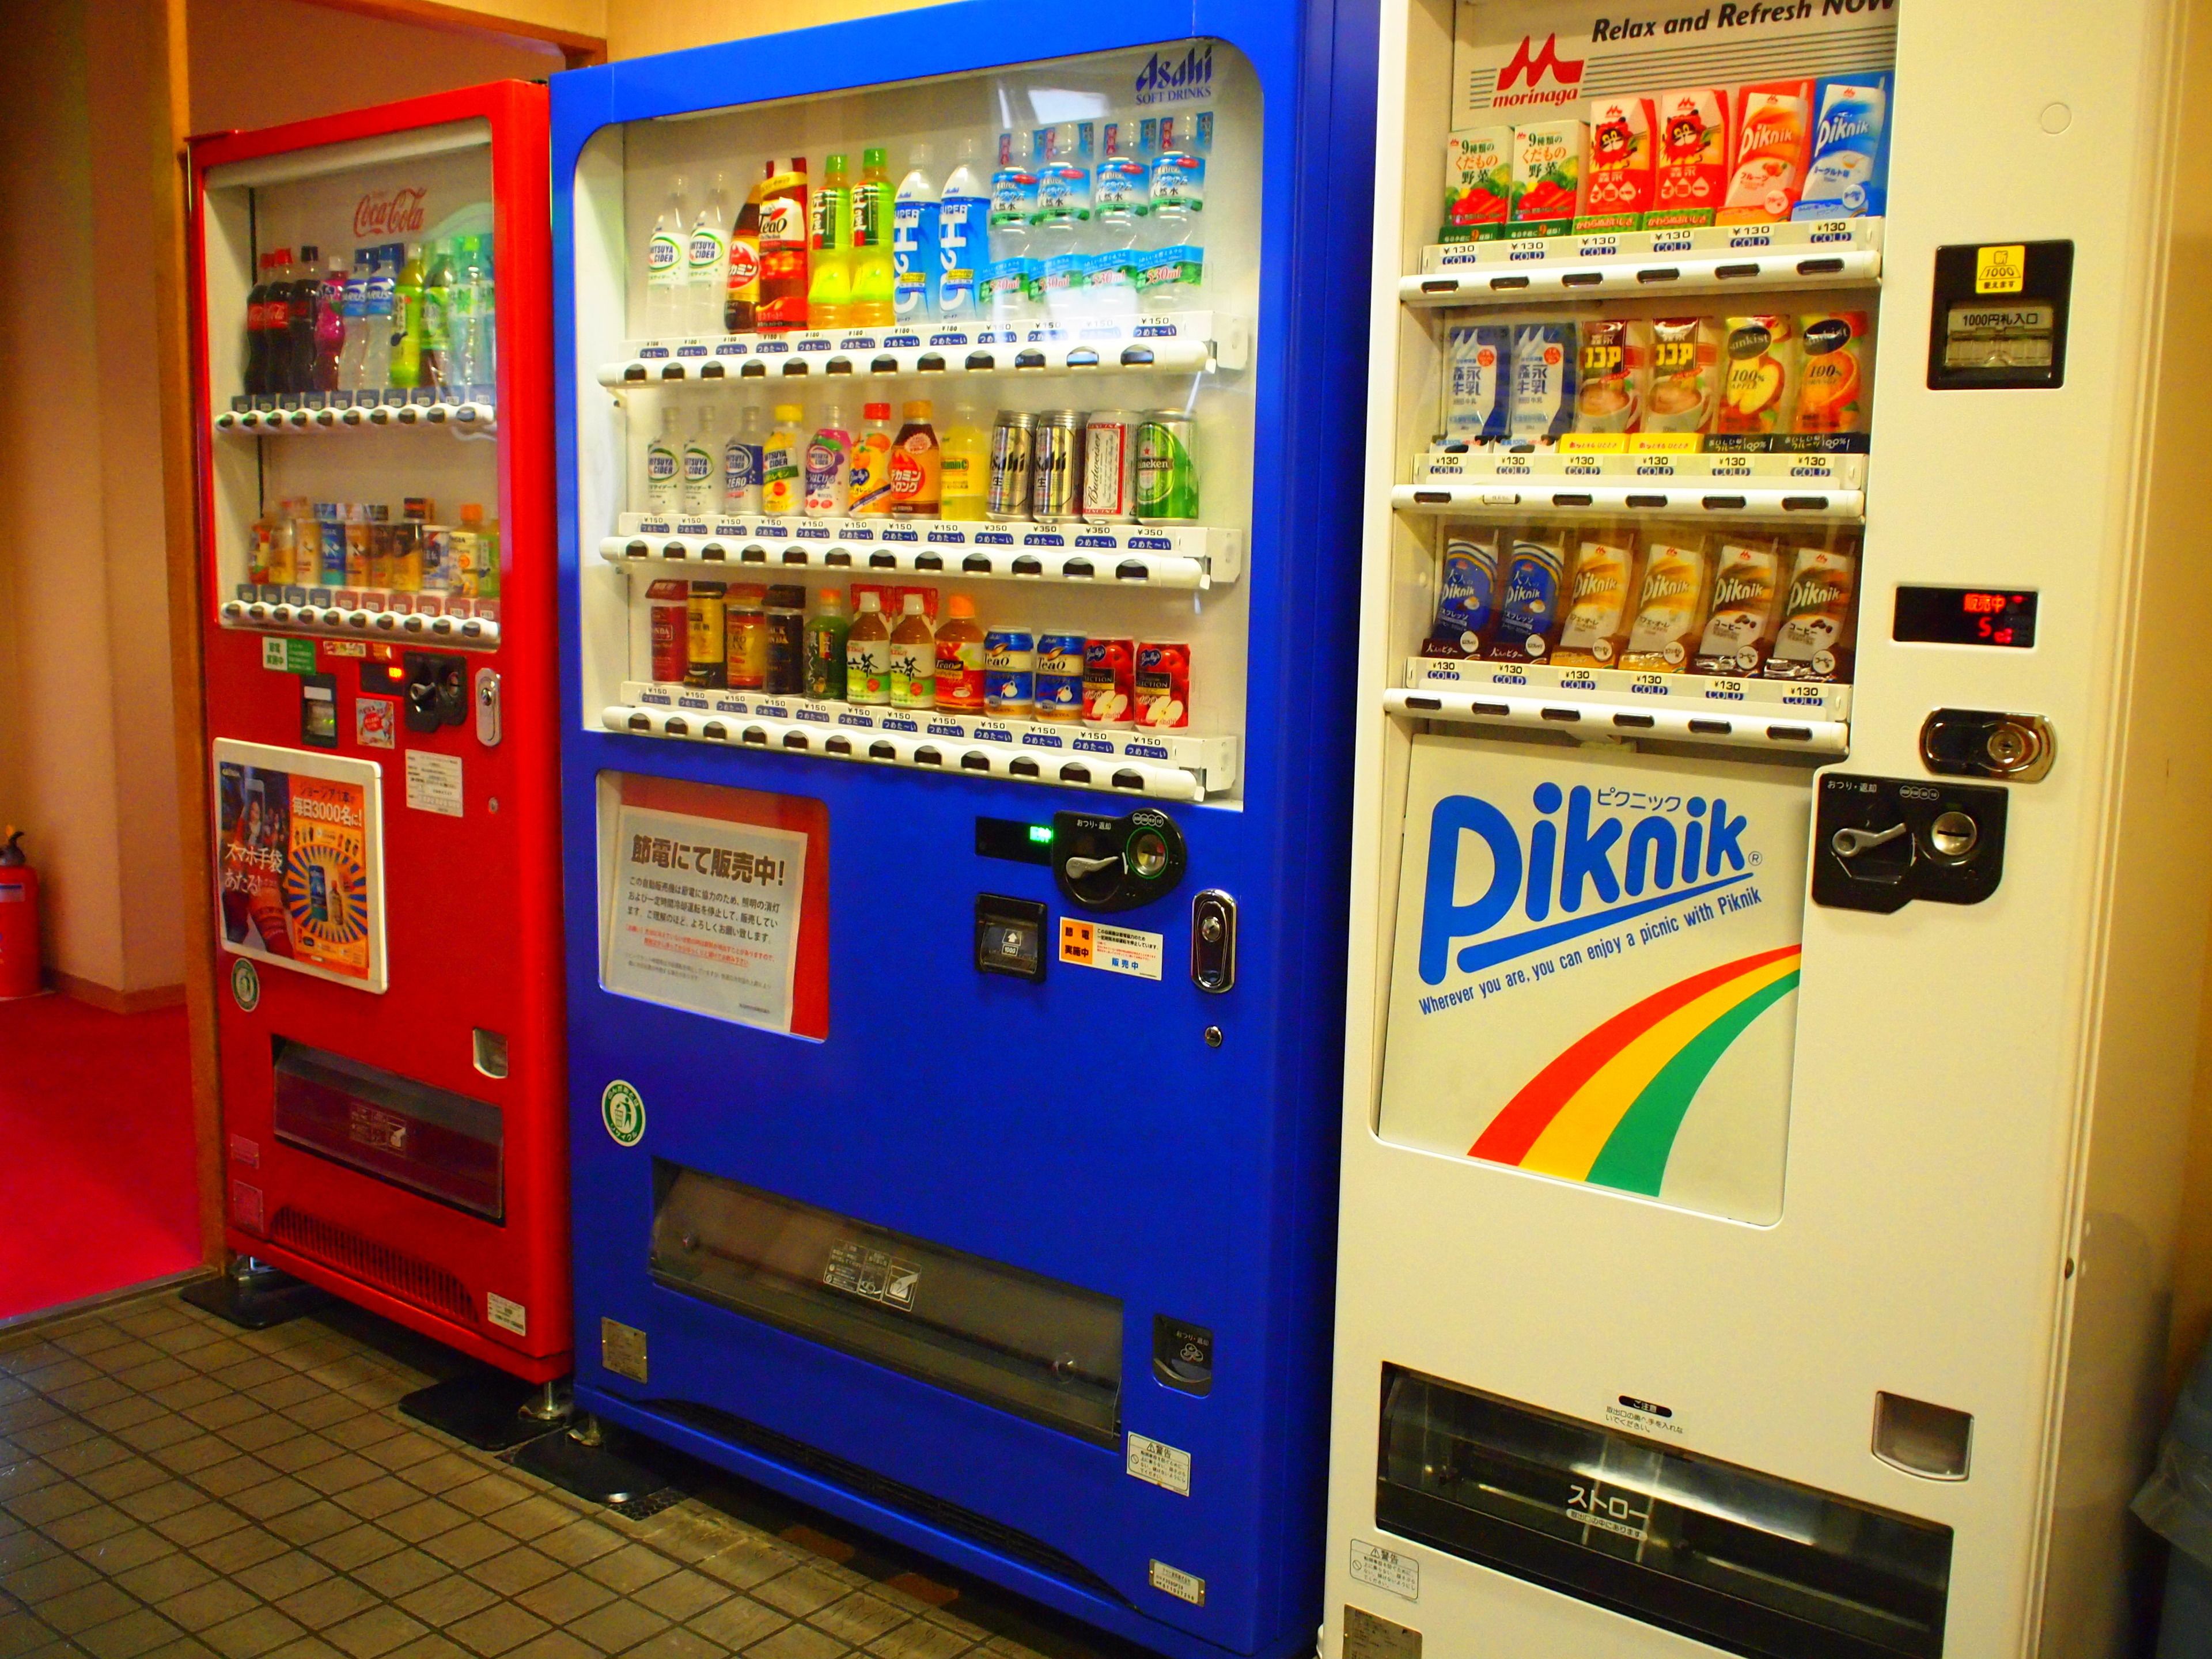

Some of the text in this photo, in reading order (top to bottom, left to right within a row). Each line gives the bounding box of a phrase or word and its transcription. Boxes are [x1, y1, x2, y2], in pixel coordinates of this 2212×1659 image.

[1592, 18, 1656, 42] Relax
[1664, 9, 1709, 34] and
[1717, 1, 1812, 28] Refresh
[1135, 47, 1213, 92] Asahi
[1136, 86, 1211, 105] SOFT DRINKS
[1493, 88, 1578, 108] morinaga
[1528, 133, 1562, 147] 9種類の
[1815, 118, 1869, 157] Piknik
[1461, 140, 1494, 155] 9種類の
[1738, 124, 1792, 164] Piknik
[1522, 147, 1566, 164] くだもの
[1456, 155, 1498, 171] くだもの
[1529, 162, 1558, 177] 野菜
[1462, 171, 1490, 183] 野菜
[1741, 172, 1768, 181] フルーツ
[759, 214, 787, 233] TeaO
[1818, 222, 1846, 231] ¥130
[1656, 231, 1691, 240] ¥130
[1733, 226, 1770, 235] ¥130
[1582, 237, 1616, 245] ¥130
[1733, 237, 1767, 247] COLD
[1813, 233, 1849, 243] COLD
[1443, 245, 1475, 255] ¥130
[1511, 243, 1543, 251] ¥130
[1583, 247, 1614, 256] COLD
[1657, 243, 1688, 252] COLD
[654, 253, 673, 263] CIDER
[696, 251, 714, 259] CIDER
[1445, 255, 1474, 264] COLD
[1513, 252, 1542, 260] COLD
[1147, 267, 1181, 284] 530ml
[1986, 267, 2014, 276] 1000
[1092, 270, 1124, 285] 530ml
[990, 277, 1020, 293] 530ml
[1039, 275, 1069, 291] 530ml
[1984, 281, 2016, 289] 使えます
[1963, 313, 2038, 326] 1000円札入口
[1732, 370, 1765, 382] 100%
[1730, 381, 1758, 389] APPLE
[770, 458, 787, 468] CIDER
[1436, 457, 1459, 465] ¥130
[1502, 457, 1525, 465] ¥130
[1570, 457, 1594, 465] ¥130
[1643, 457, 1668, 465] ¥130
[1719, 457, 1745, 465] ¥130
[1798, 457, 1825, 465] ¥130
[690, 467, 707, 475] CIDER
[1088, 433, 1101, 507] Budweiser
[1568, 467, 1598, 475] COLD
[1794, 468, 1827, 476] COLD
[727, 477, 747, 488] ZERO
[993, 477, 1003, 486] 生
[1441, 584, 1475, 602] Piknik
[1571, 573, 1618, 605] Piknik
[1641, 575, 1690, 608] Piknik
[1505, 586, 1540, 605] Piknik
[1713, 578, 1763, 612] Piknik
[1787, 581, 1840, 616] Piknik
[1715, 620, 1741, 630] コーヒー
[1790, 623, 1817, 634] コーヒー
[984, 653, 1009, 666] TeaO
[1038, 657, 1066, 670] TeaO
[1499, 665, 1522, 673] ¥130
[1430, 671, 1457, 680] COLD
[1566, 671, 1589, 679] ¥130
[1637, 676, 1661, 684] ¥130
[1495, 676, 1524, 685] COLD
[1564, 681, 1593, 690] COLD
[1635, 685, 1665, 695] COLD
[1715, 681, 1740, 691] ¥130
[1791, 687, 1819, 695] ¥130
[1709, 692, 1741, 700] COLD
[805, 703, 826, 711] ¥150
[1786, 698, 1820, 706] COLD
[848, 707, 870, 715] ¥150
[888, 711, 910, 719] ¥150
[981, 721, 1005, 729] ¥150
[1031, 726, 1055, 734] ¥150
[1134, 737, 1160, 745] ¥150
[1596, 786, 1681, 813] ピクニック
[293, 796, 362, 827] 毎日3000名に!
[225, 843, 282, 873] スマホ手袋
[632, 834, 785, 886] 節電にて販売中!
[1418, 781, 1747, 986] Piknik
[1065, 945, 1089, 957] 実施中
[1418, 887, 1762, 1016] Wherever you are, you can enjoy a picnic with Piknik
[1112, 957, 1138, 969] 販売中
[1634, 1400, 1657, 1413] ご注意
[1568, 1484, 1649, 1520] ストロー
